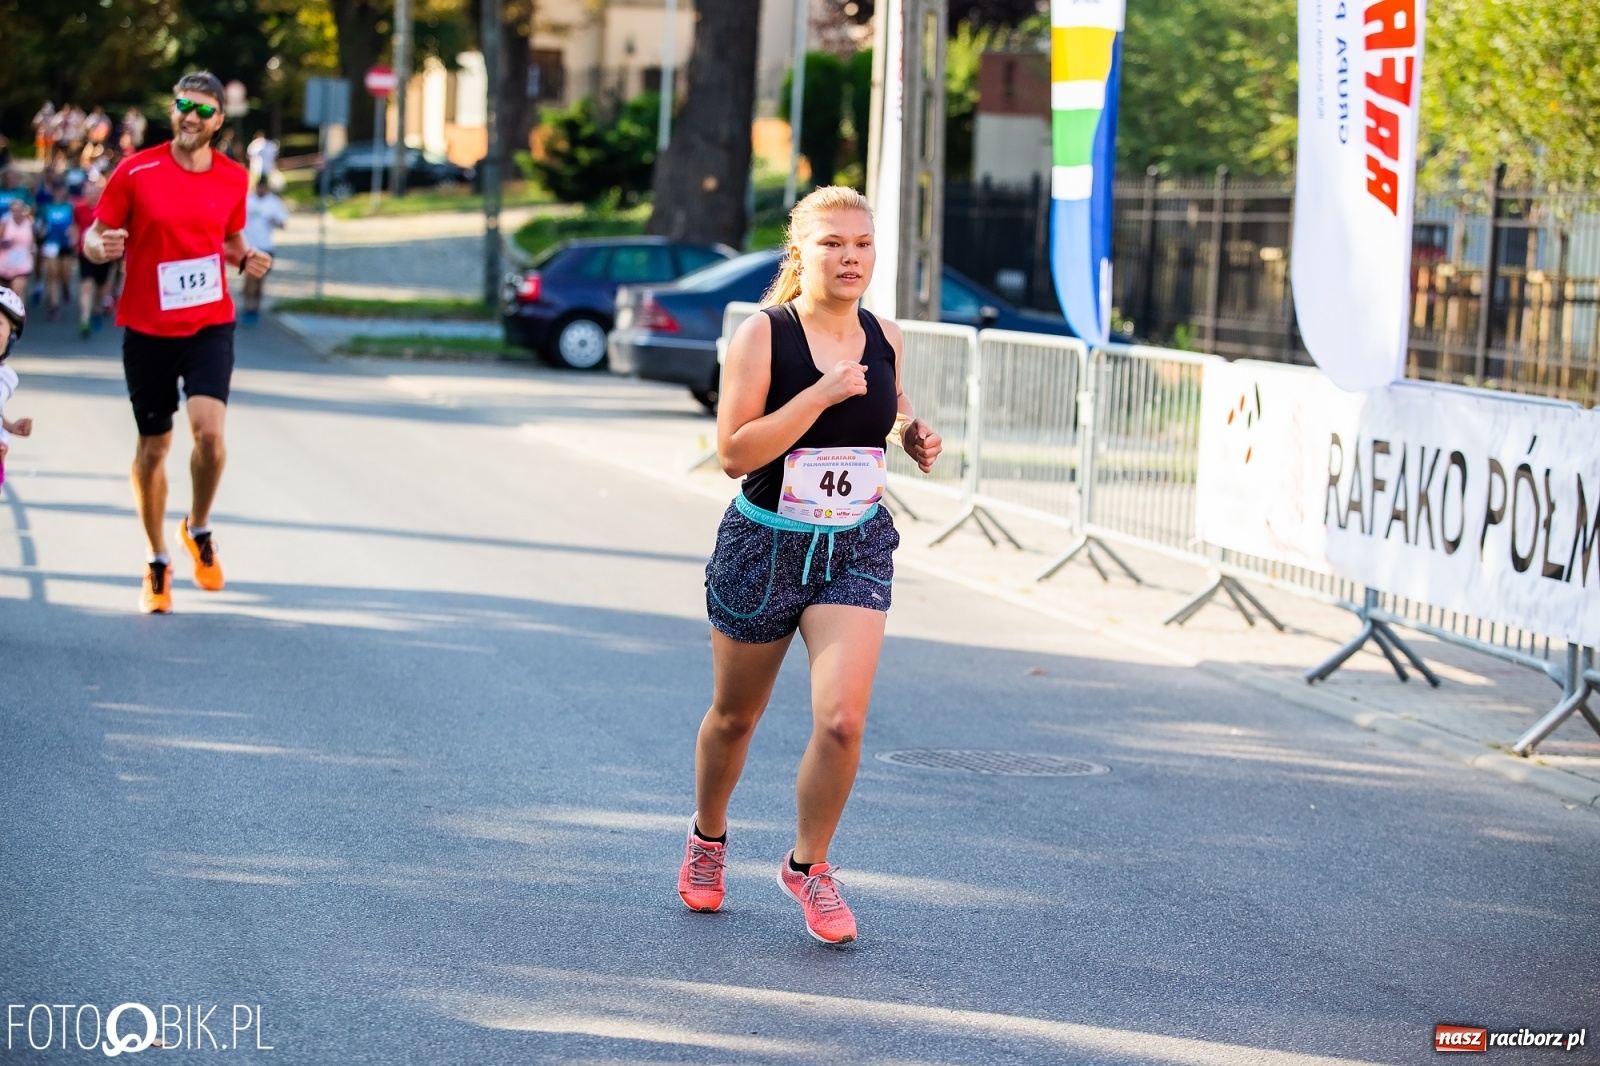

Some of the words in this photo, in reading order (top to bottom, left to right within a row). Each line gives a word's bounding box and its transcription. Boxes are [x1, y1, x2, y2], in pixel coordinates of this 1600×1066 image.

[179, 271, 206, 290] 153
[819, 469, 852, 497] 46
[1323, 432, 1468, 555] RAFAKO
